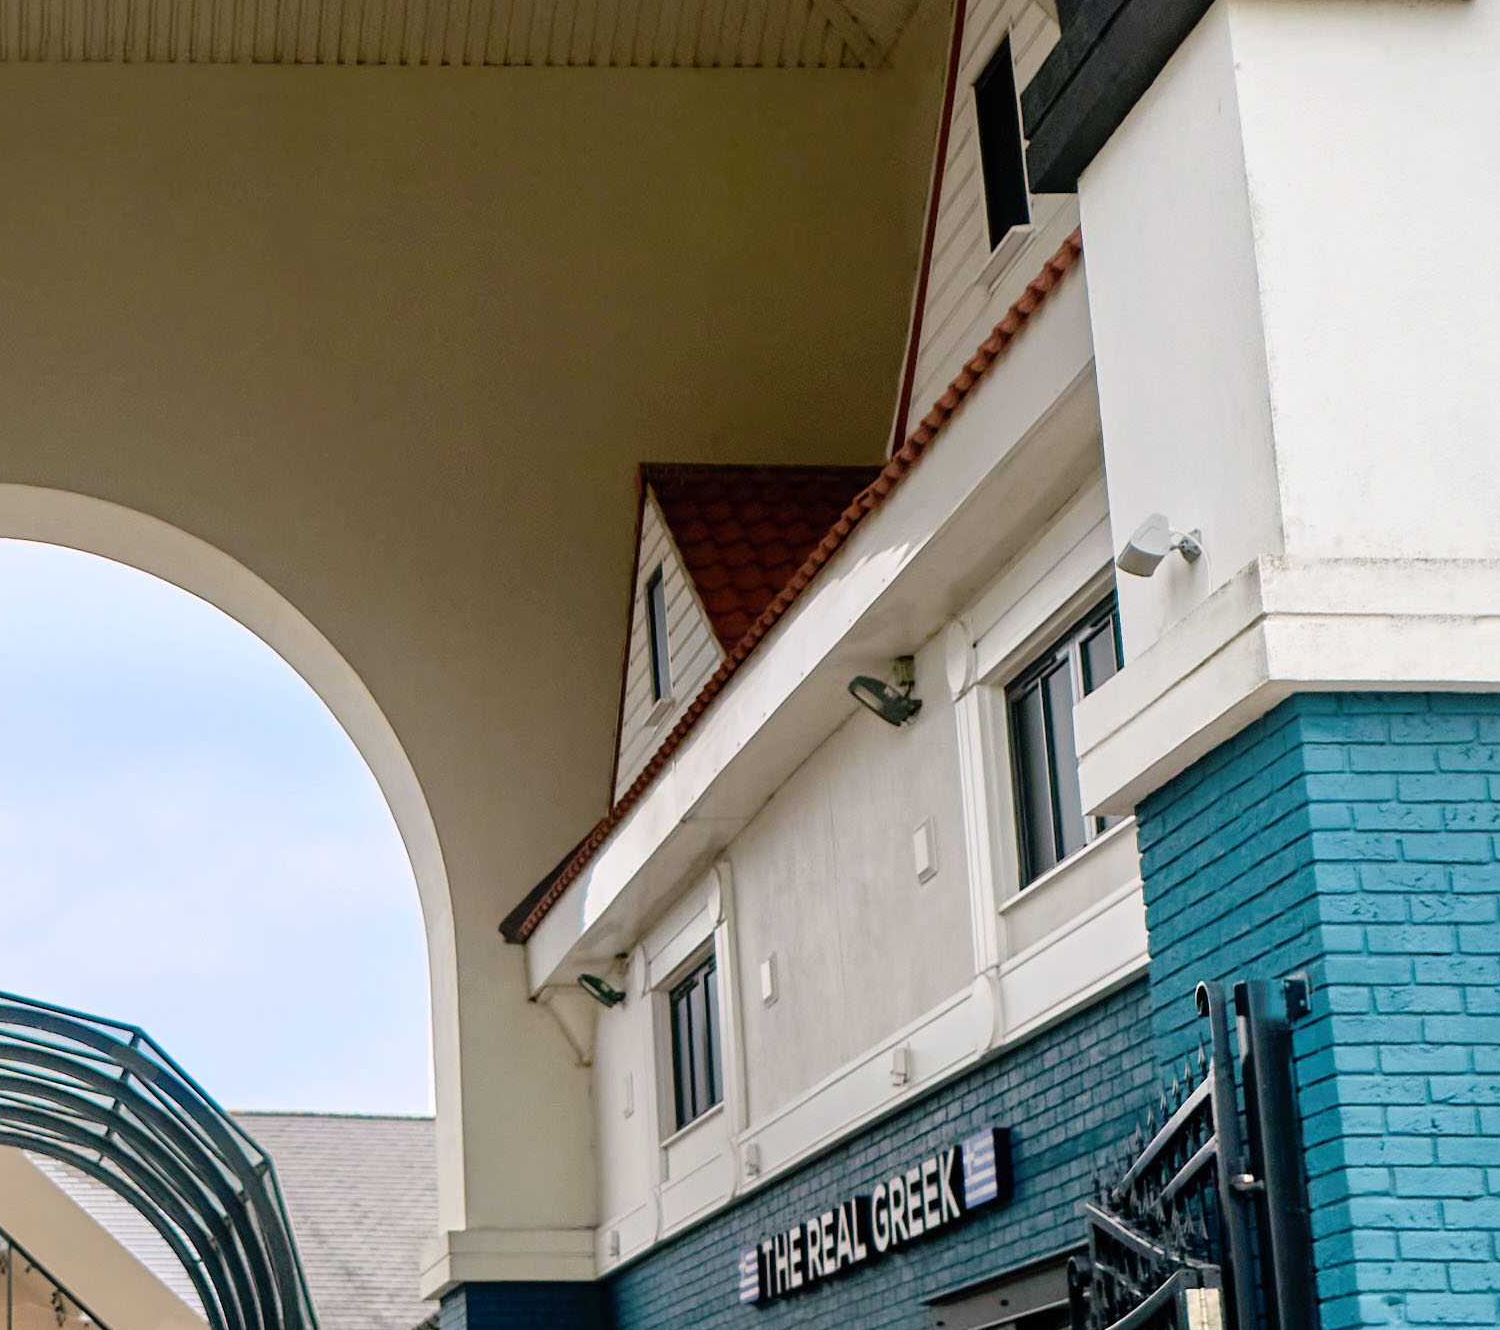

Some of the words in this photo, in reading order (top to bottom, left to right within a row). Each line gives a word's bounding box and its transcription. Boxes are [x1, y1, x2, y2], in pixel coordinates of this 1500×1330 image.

[762, 1225, 804, 1298] THE
[806, 1197, 867, 1281] REAL
[870, 1147, 961, 1253] GREEK
